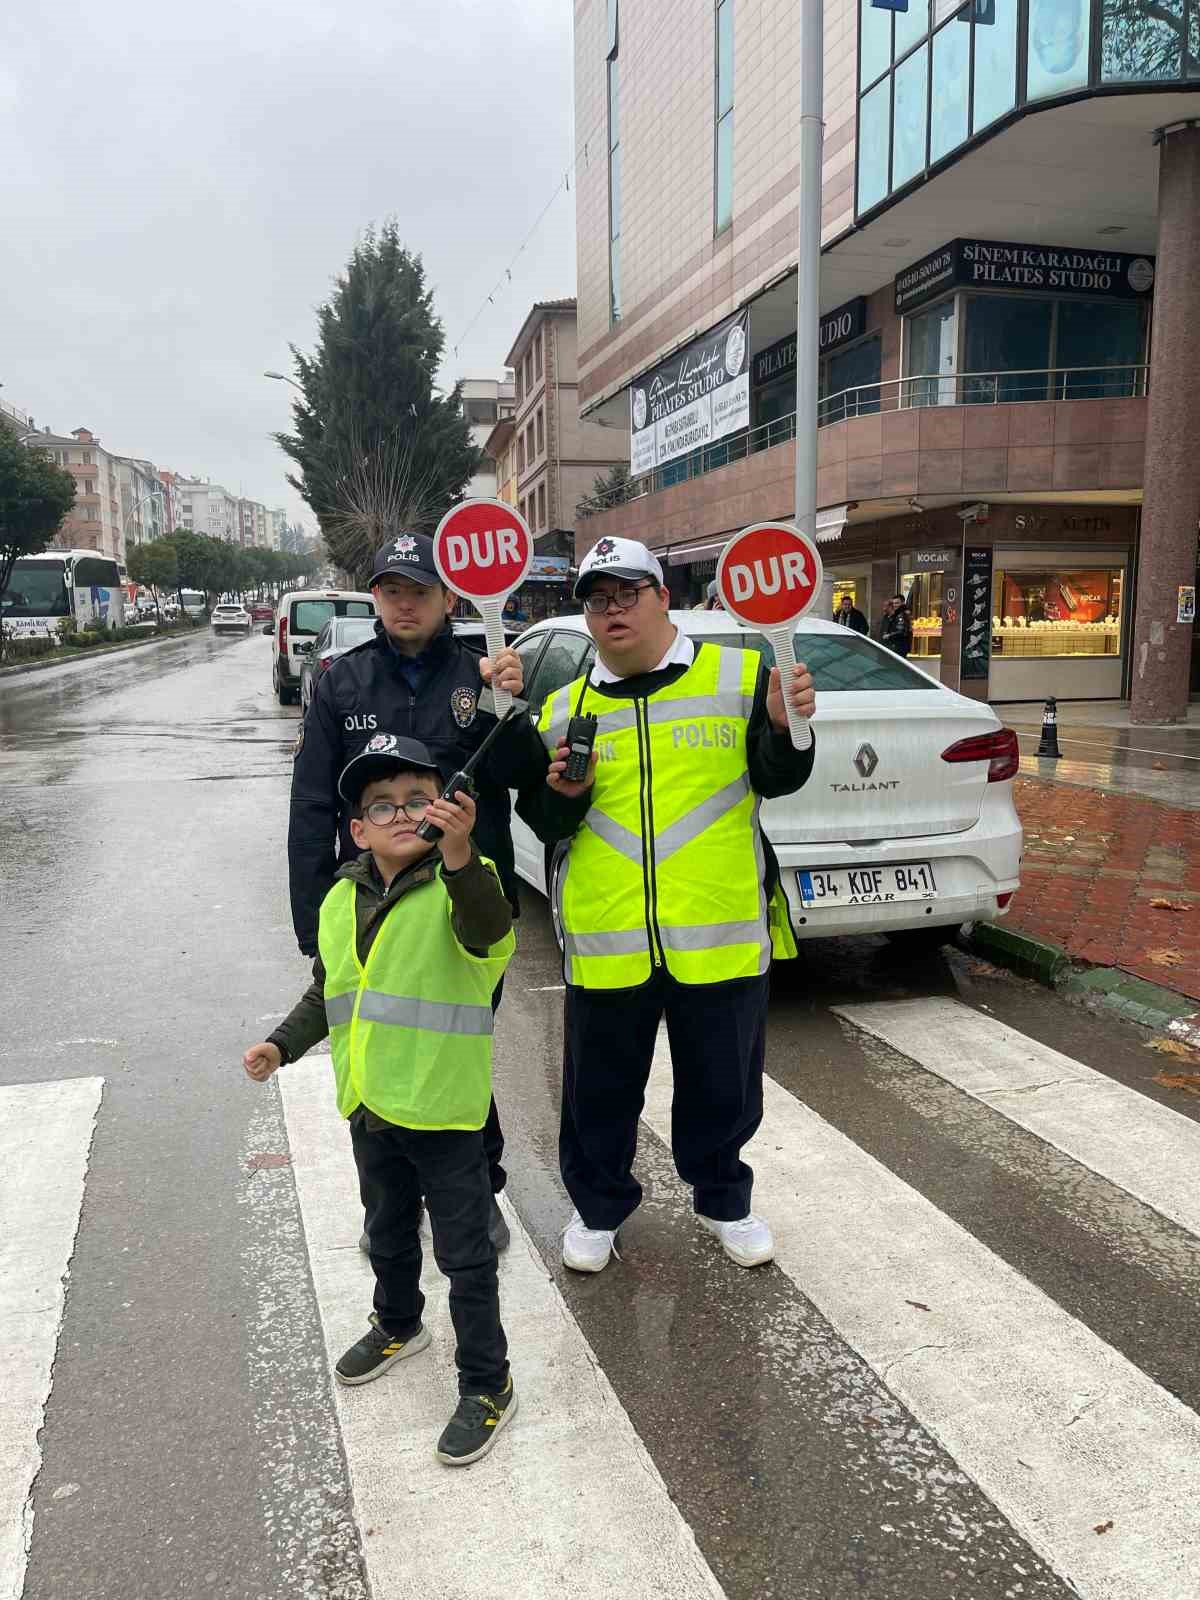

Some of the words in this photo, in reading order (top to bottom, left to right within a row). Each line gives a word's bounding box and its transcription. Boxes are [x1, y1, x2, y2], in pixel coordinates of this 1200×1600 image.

[963, 245, 1019, 265] SİNEM
[1022, 250, 1121, 273] KARADAĞLI
[973, 263, 1044, 285] PİLATES
[1049, 270, 1112, 289] STUDIO
[760, 342, 798, 378] PİLATE
[819, 312, 852, 346] UDIO
[651, 389, 686, 421] PİLATES
[687, 367, 724, 401] STUDIO
[446, 528, 522, 571] DUR
[728, 551, 811, 602] DUR
[672, 722, 736, 748] POLİSİ
[830, 781, 900, 793] TALIANT
[813, 873, 838, 897] 34
[848, 870, 882, 894] KDF
[895, 867, 928, 891] 841
[849, 893, 895, 903] ACAR
